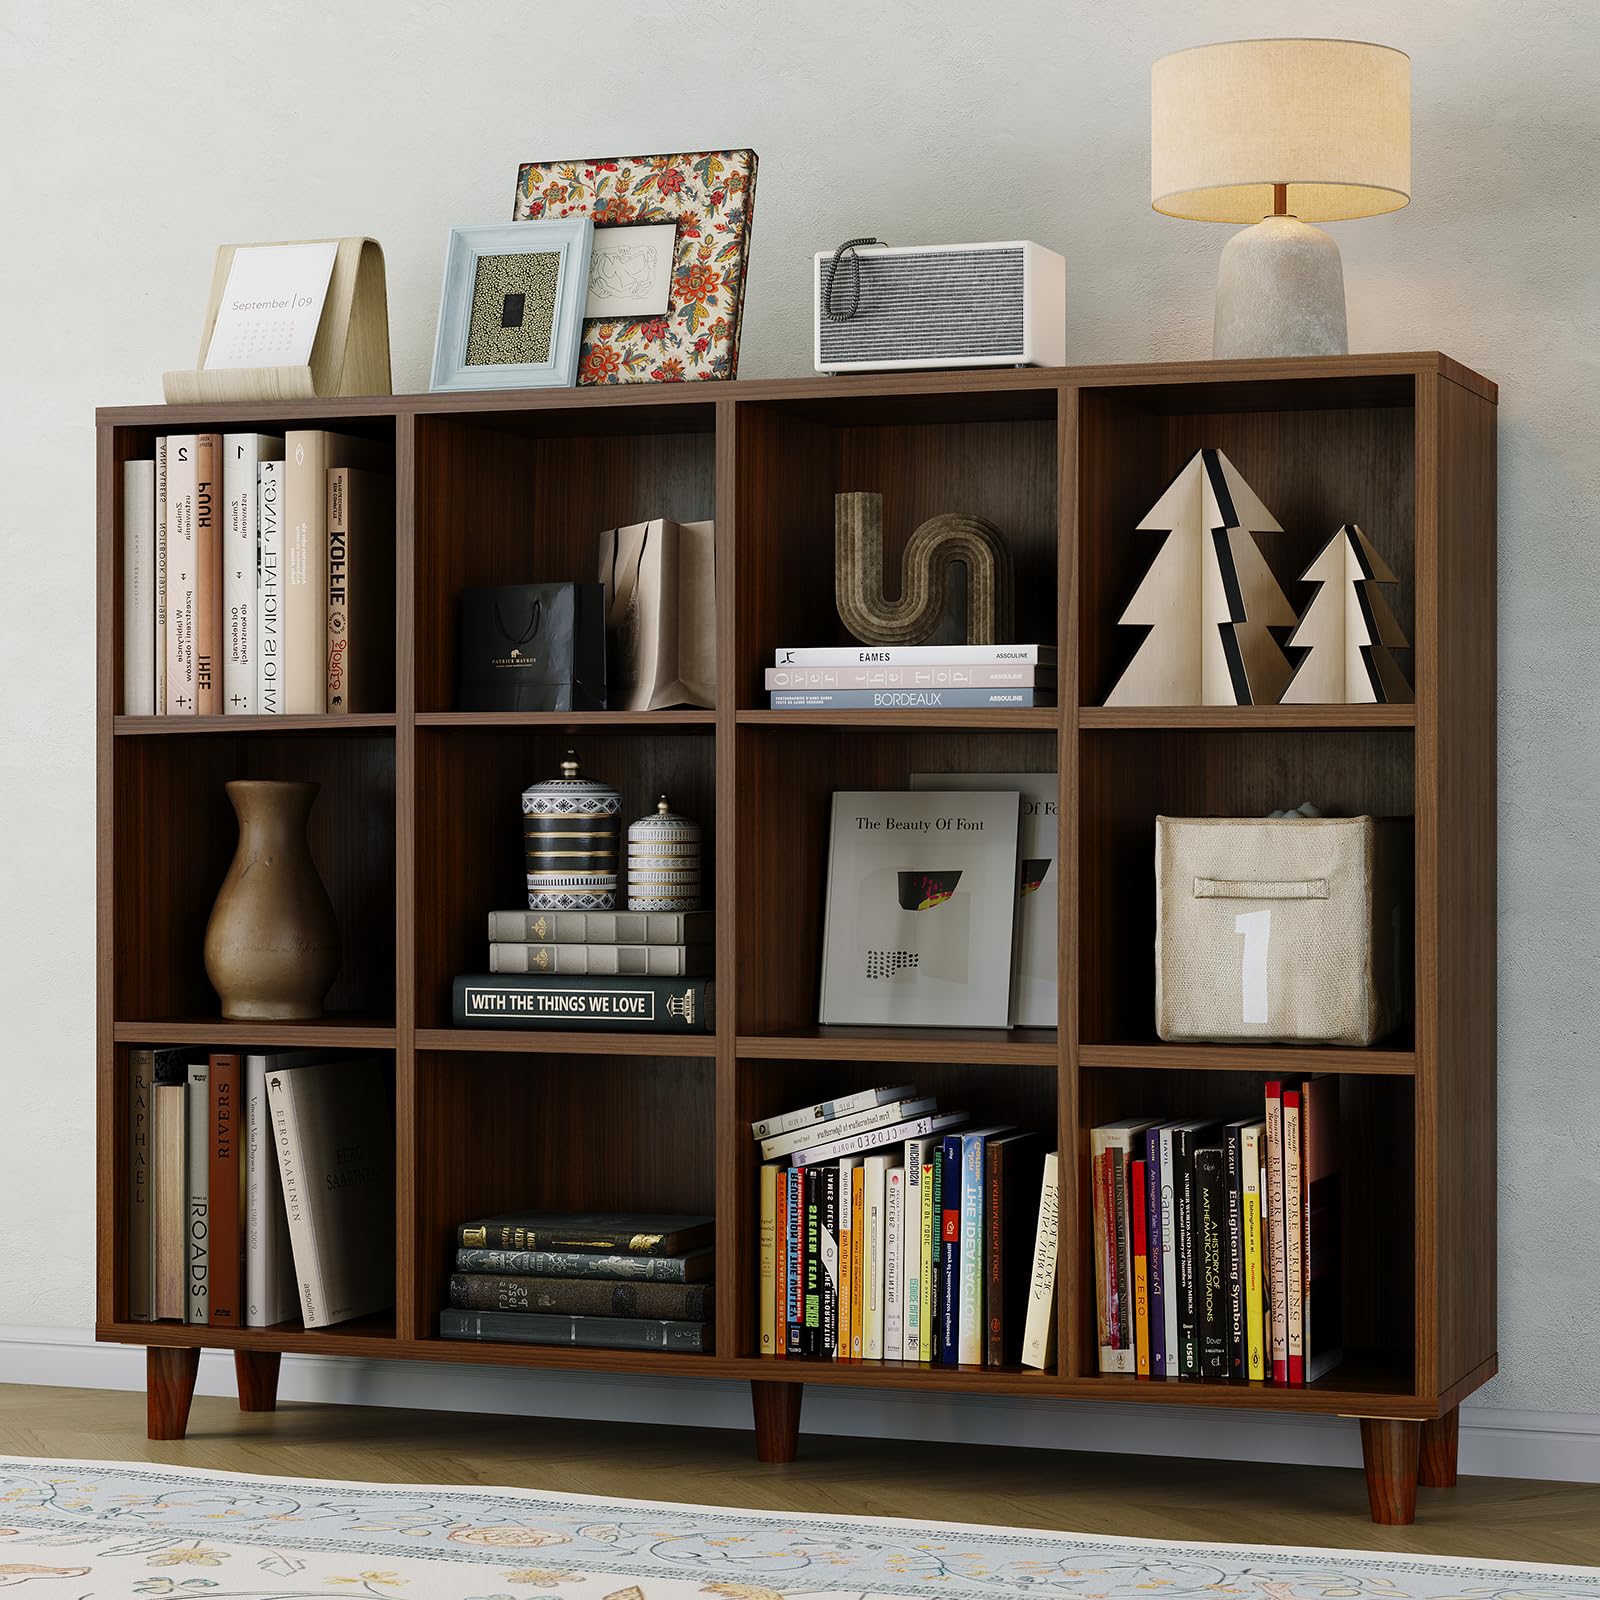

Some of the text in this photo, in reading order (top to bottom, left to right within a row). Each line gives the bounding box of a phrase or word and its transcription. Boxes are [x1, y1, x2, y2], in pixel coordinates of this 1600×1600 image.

[232, 297, 313, 311] September 09
[859, 653, 891, 663] EAMES
[874, 693, 942, 706] BORDEAUX
[855, 817, 984, 833] The Beauty Of Font
[1235, 910, 1271, 1024] 1
[471, 994, 645, 1013] WITH THE THINGS WE LOVE
[218, 1082, 231, 1159] RIVERS
[250, 1096, 258, 1126] Vincent
[134, 1074, 147, 1203] RAPHAEL
[250, 1127, 258, 1142] Van
[249, 1144, 258, 1173] Duysen
[276, 1110, 301, 1222] EERO SAARINEN
[1149, 1181, 1157, 1214] Imaginary
[1151, 1229, 1159, 1246] The
[1160, 1184, 1173, 1253] Gamma
[191, 1203, 208, 1297] ROADS
[1115, 1164, 1128, 1334] THE UNIVERSAL HISTORY NUMBERS
[1150, 1247, 1159, 1270] Story
[1202, 1187, 1214, 1322] MATHEMATICAL NOTATIONS
[1273, 1156, 1284, 1323] BEFORE WRITING
[1290, 1163, 1300, 1321] BEFORE WRITING
[1212, 1232, 1221, 1290] HISTORY OF
[1228, 1190, 1241, 1344] Enlightening Symbols
[303, 1283, 315, 1322] assouline
[1137, 1275, 1146, 1316] ZERO
[1186, 1342, 1194, 1368] USED
[1206, 1336, 1222, 1345] Dover
